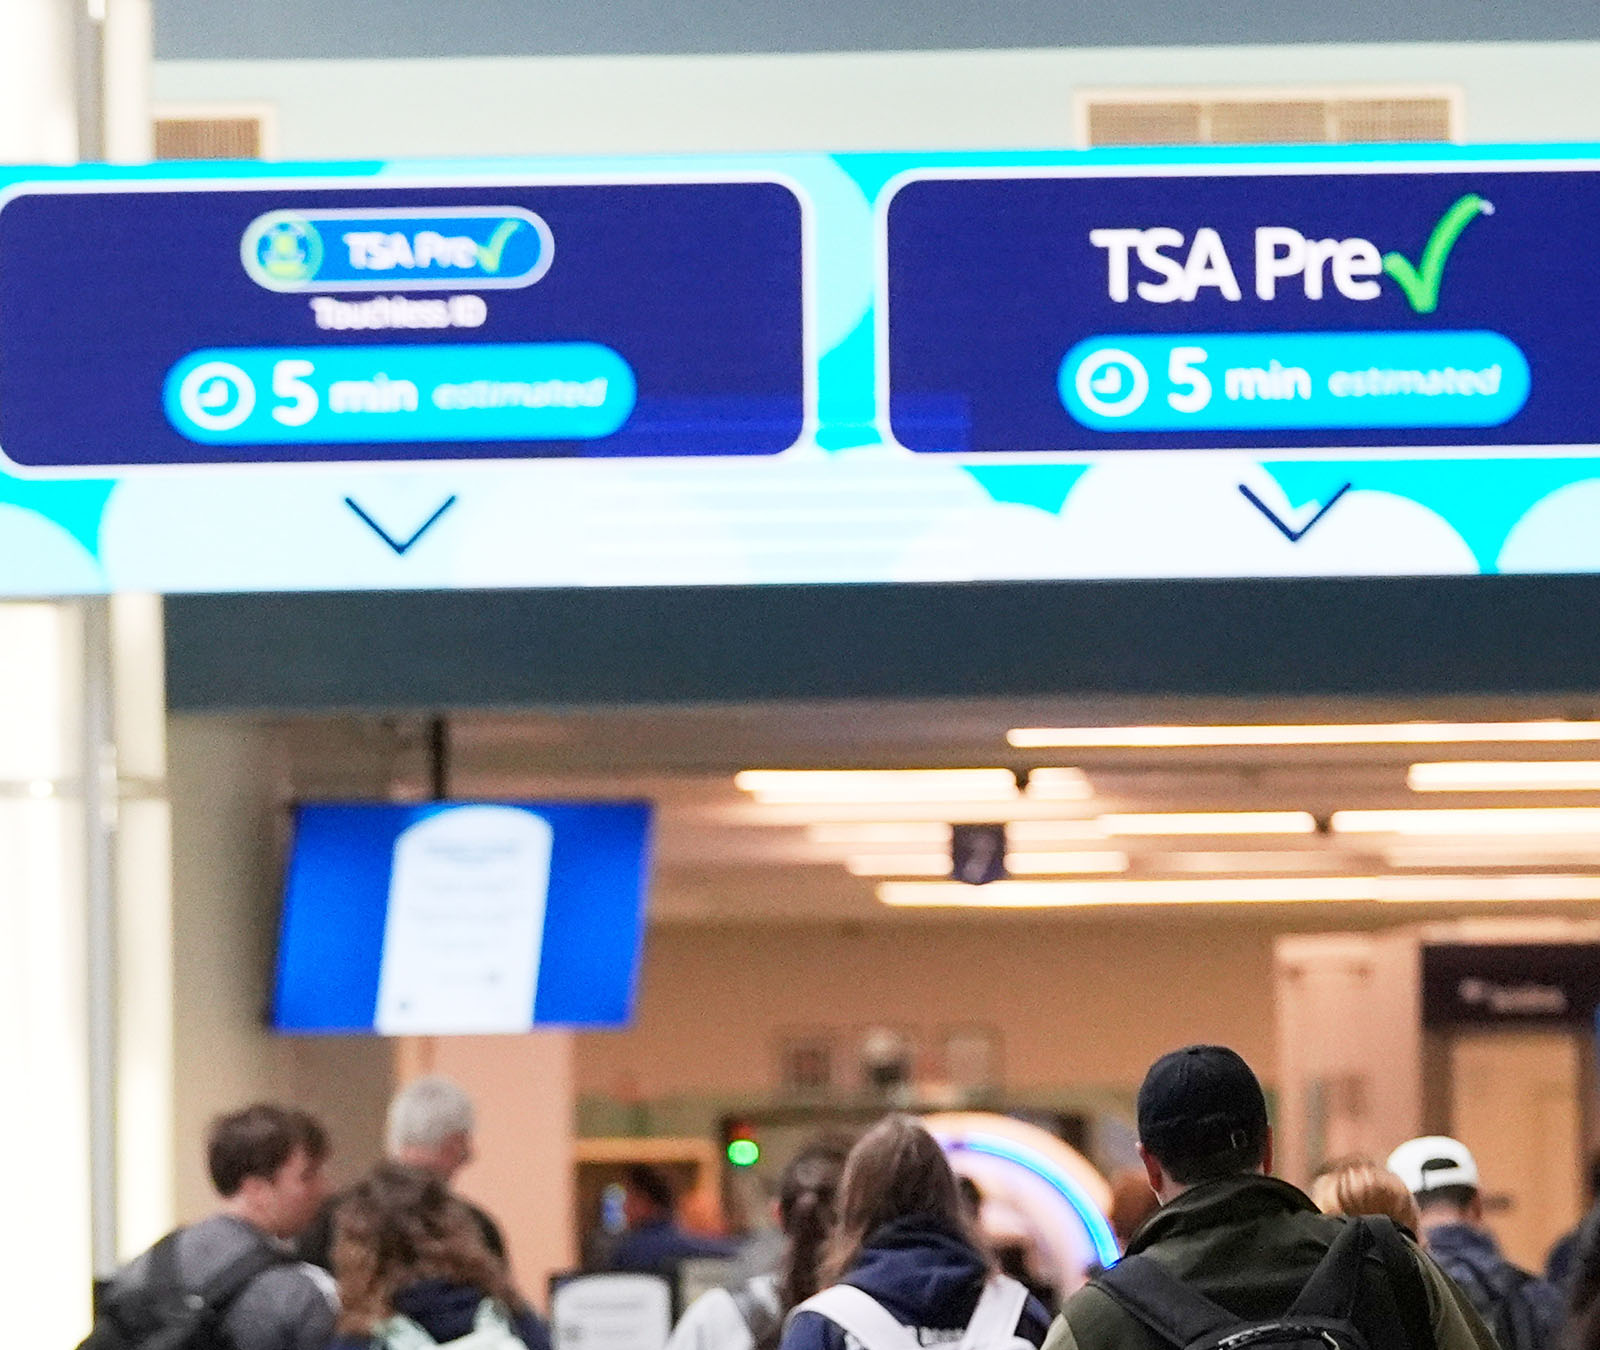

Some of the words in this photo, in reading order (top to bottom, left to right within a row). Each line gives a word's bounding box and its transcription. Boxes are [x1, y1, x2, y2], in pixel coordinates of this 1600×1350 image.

[344, 231, 417, 269] TSA
[420, 231, 478, 269] Pre
[1090, 227, 1242, 303] TSA
[1255, 226, 1383, 301] Pre
[311, 296, 445, 331] Touchless
[448, 294, 488, 328] ID
[272, 359, 319, 427] 5
[329, 373, 419, 413] min
[432, 377, 609, 410] estimated
[1167, 346, 1212, 413] 5
[1225, 360, 1312, 400] min
[1328, 363, 1503, 397] estimated
